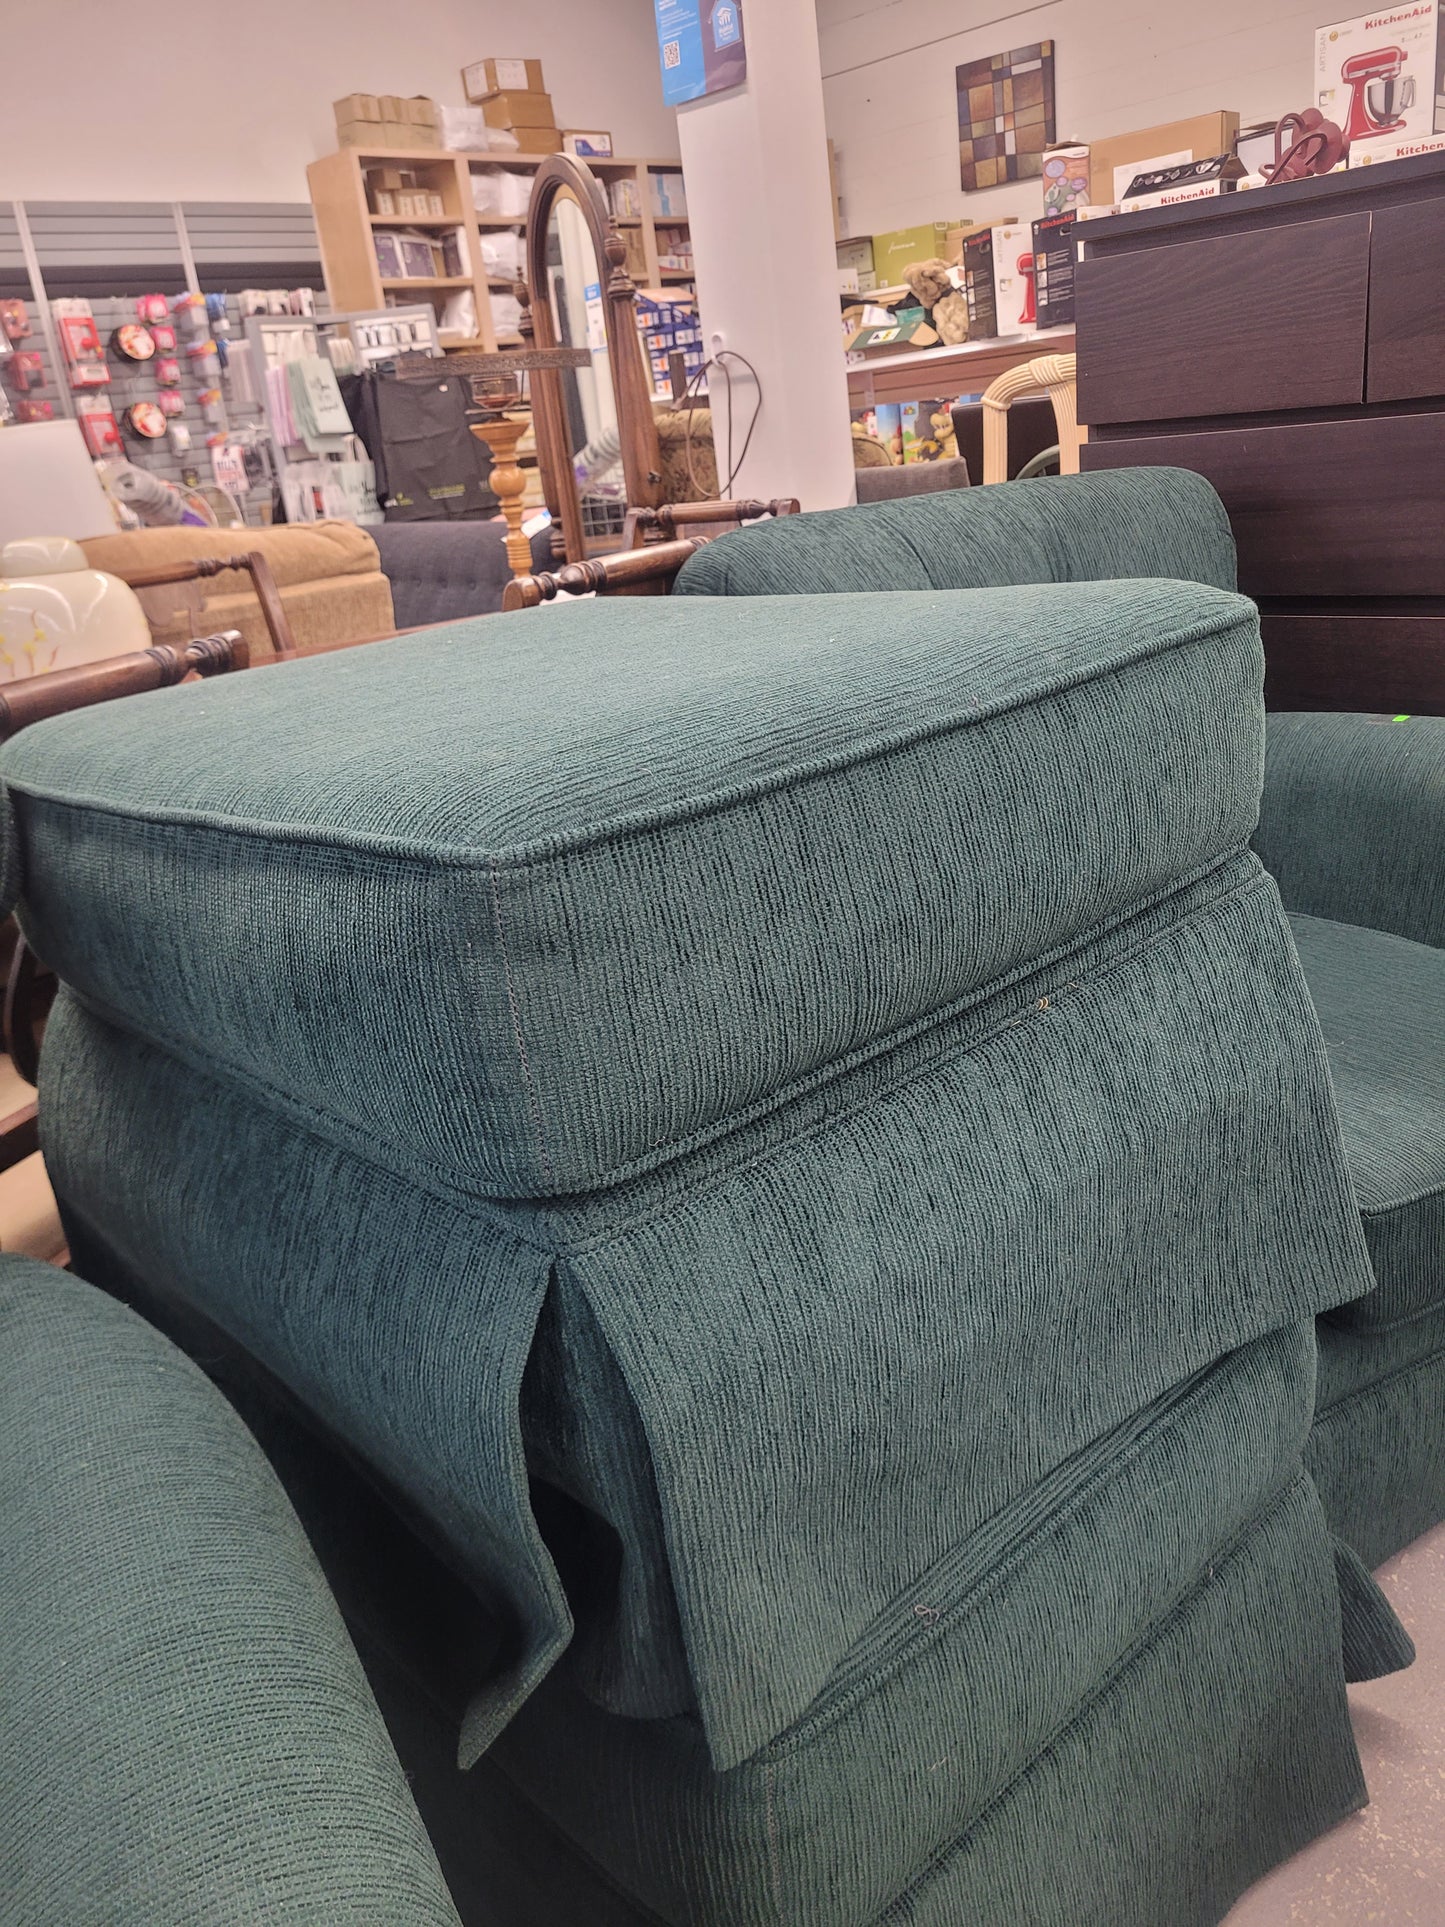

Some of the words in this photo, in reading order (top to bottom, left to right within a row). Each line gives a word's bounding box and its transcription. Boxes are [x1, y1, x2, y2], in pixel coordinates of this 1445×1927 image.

[1364, 5, 1432, 30] KitchenAid
[1396, 143, 1445, 157] Kitchen
[1160, 188, 1215, 205] KitchenAid
